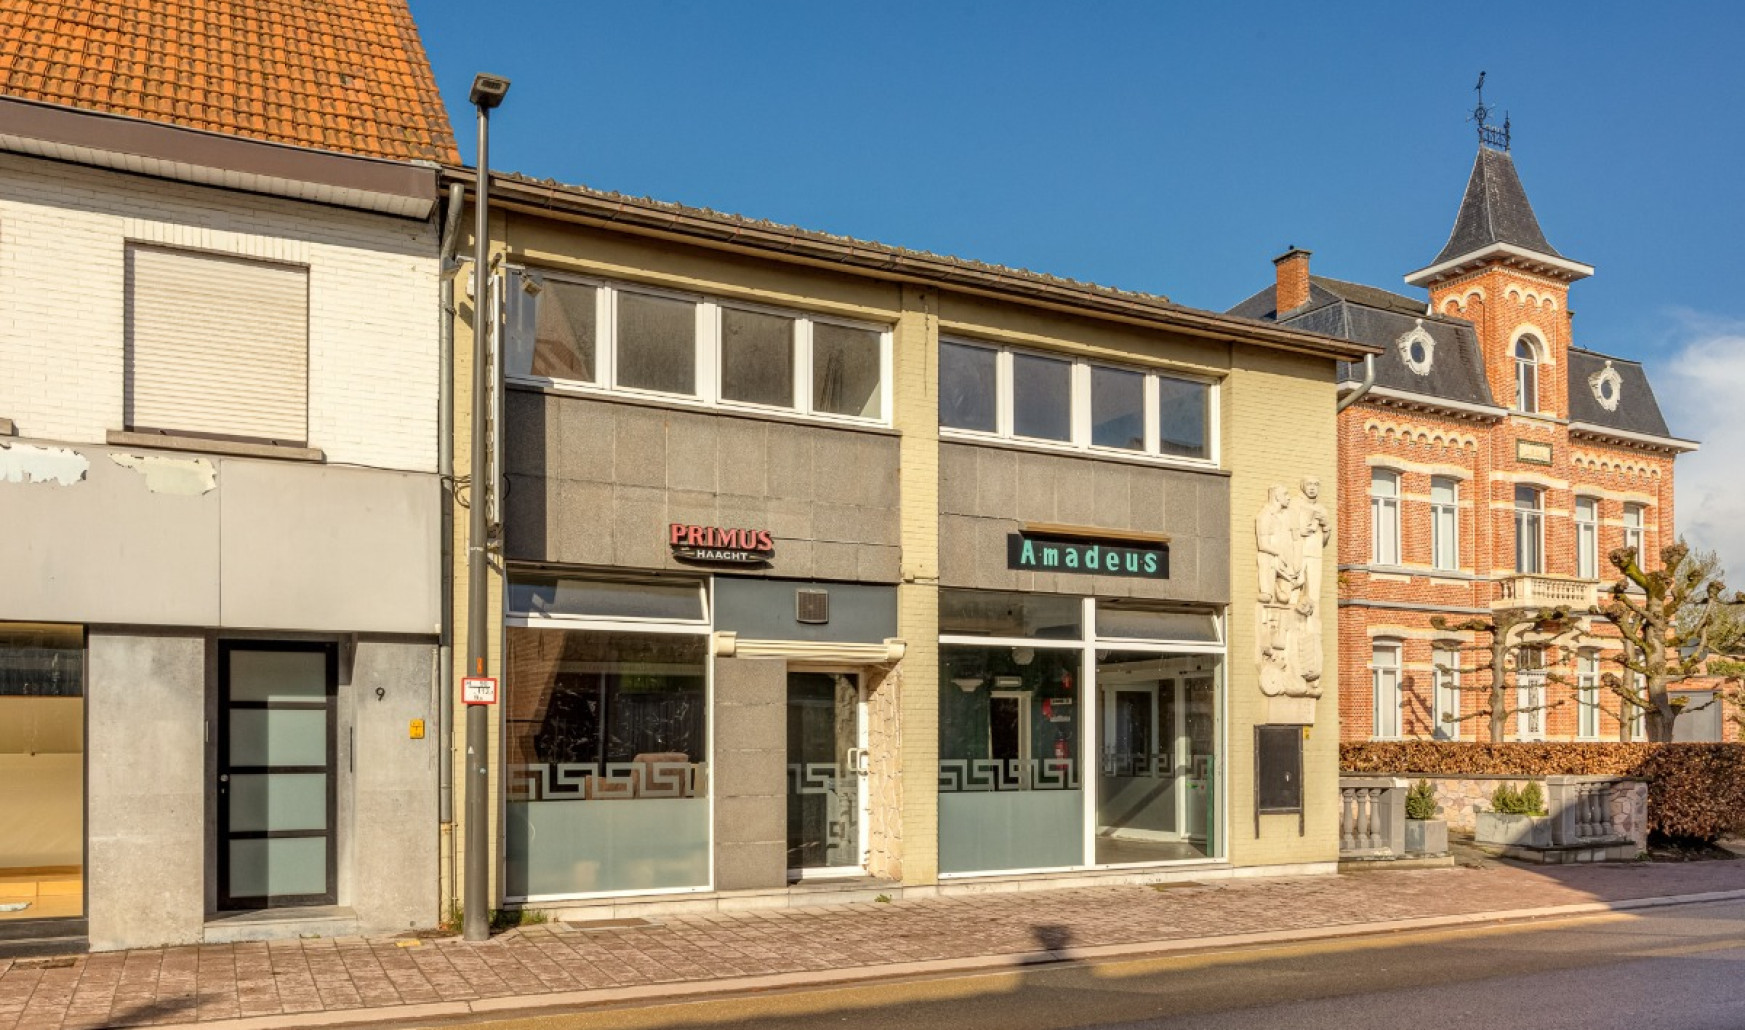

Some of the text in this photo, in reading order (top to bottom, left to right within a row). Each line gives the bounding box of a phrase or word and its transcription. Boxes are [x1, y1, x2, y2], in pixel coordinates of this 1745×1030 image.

[669, 523, 773, 551] PRIMUS
[696, 549, 748, 561] HAACHT
[1020, 539, 1157, 573] Amadeus
[375, 687, 385, 701] 9
